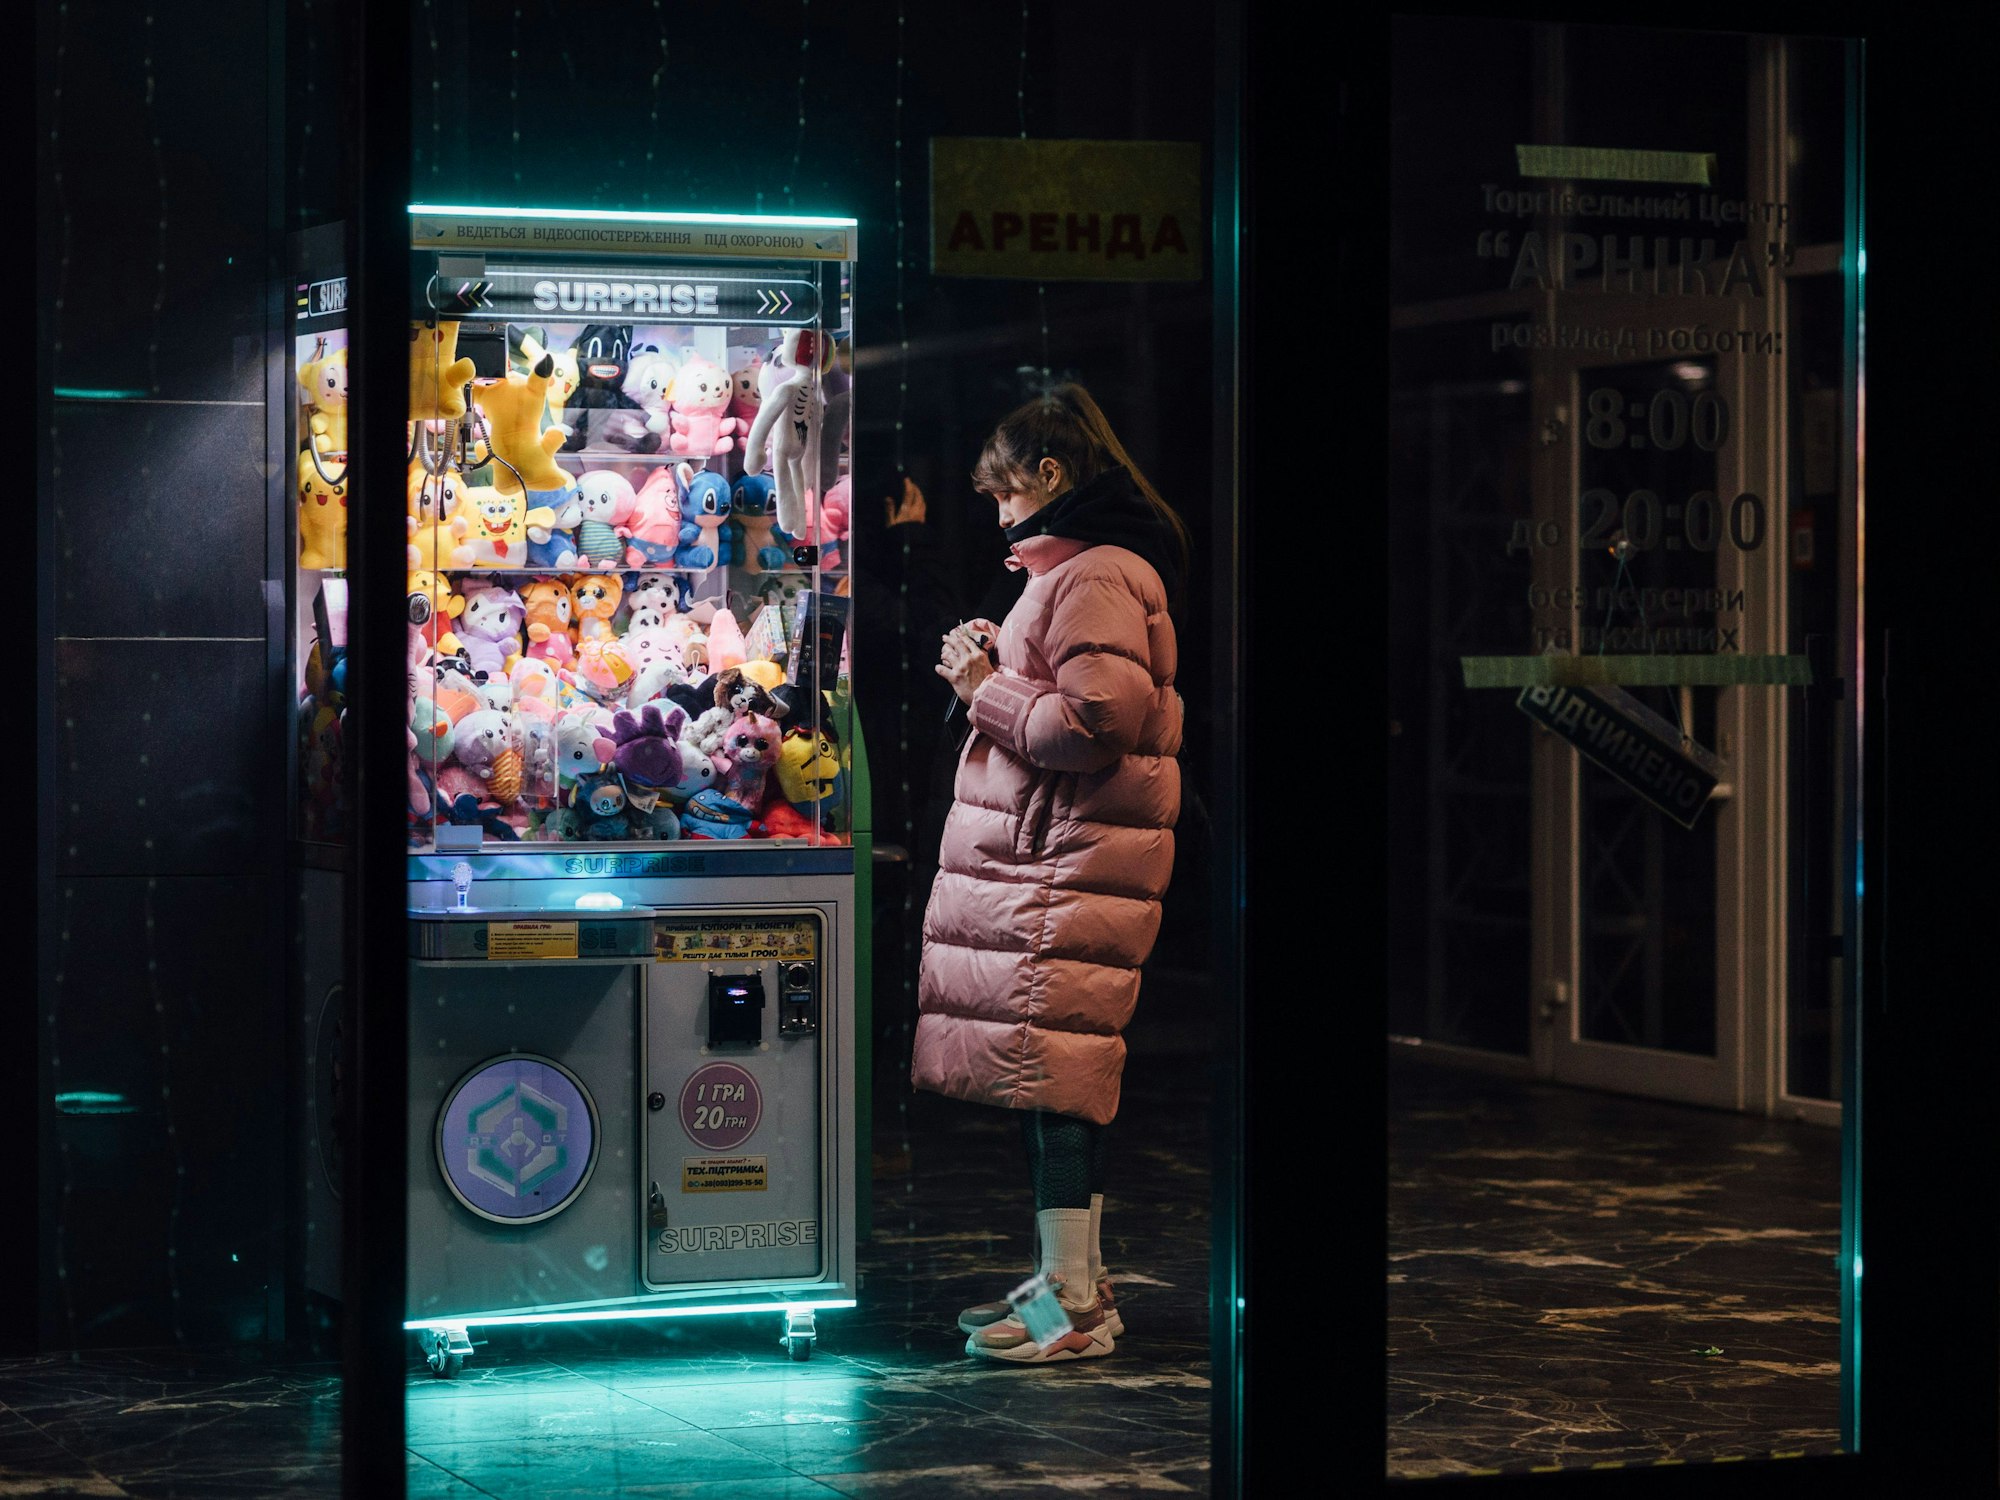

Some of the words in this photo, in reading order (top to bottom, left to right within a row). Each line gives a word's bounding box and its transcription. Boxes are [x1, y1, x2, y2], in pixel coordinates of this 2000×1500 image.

[1699, 193, 1790, 228] Центр
[457, 225, 526, 240] ВЕДЕТЬСЯ
[533, 228, 691, 245] ВІДЕОСПОСТЕРЕЖЕННЯ
[704, 233, 728, 248] ПІД
[730, 234, 804, 249] ОХОРОНОЮ
[948, 211, 1187, 260] АРЕНДА
[533, 280, 719, 315] SURPRISE
[1490, 321, 1637, 356] розклад
[1585, 387, 1729, 451] 8:00
[1506, 518, 1560, 557] до
[1579, 488, 1766, 551] 20:00
[1528, 582, 1586, 611] без
[1596, 586, 1745, 617] перерви
[1529, 685, 1701, 809] ВІДЧИНЕНО
[565, 855, 706, 874] SURPRISE
[700, 922, 742, 931] КУПЮРИ
[754, 921, 796, 930] МОНЕТИ
[751, 949, 778, 958] ГРОЮ
[697, 1083, 706, 1102] 1
[711, 1083, 745, 1102] ГРА
[659, 1220, 818, 1254] SURPRISE
